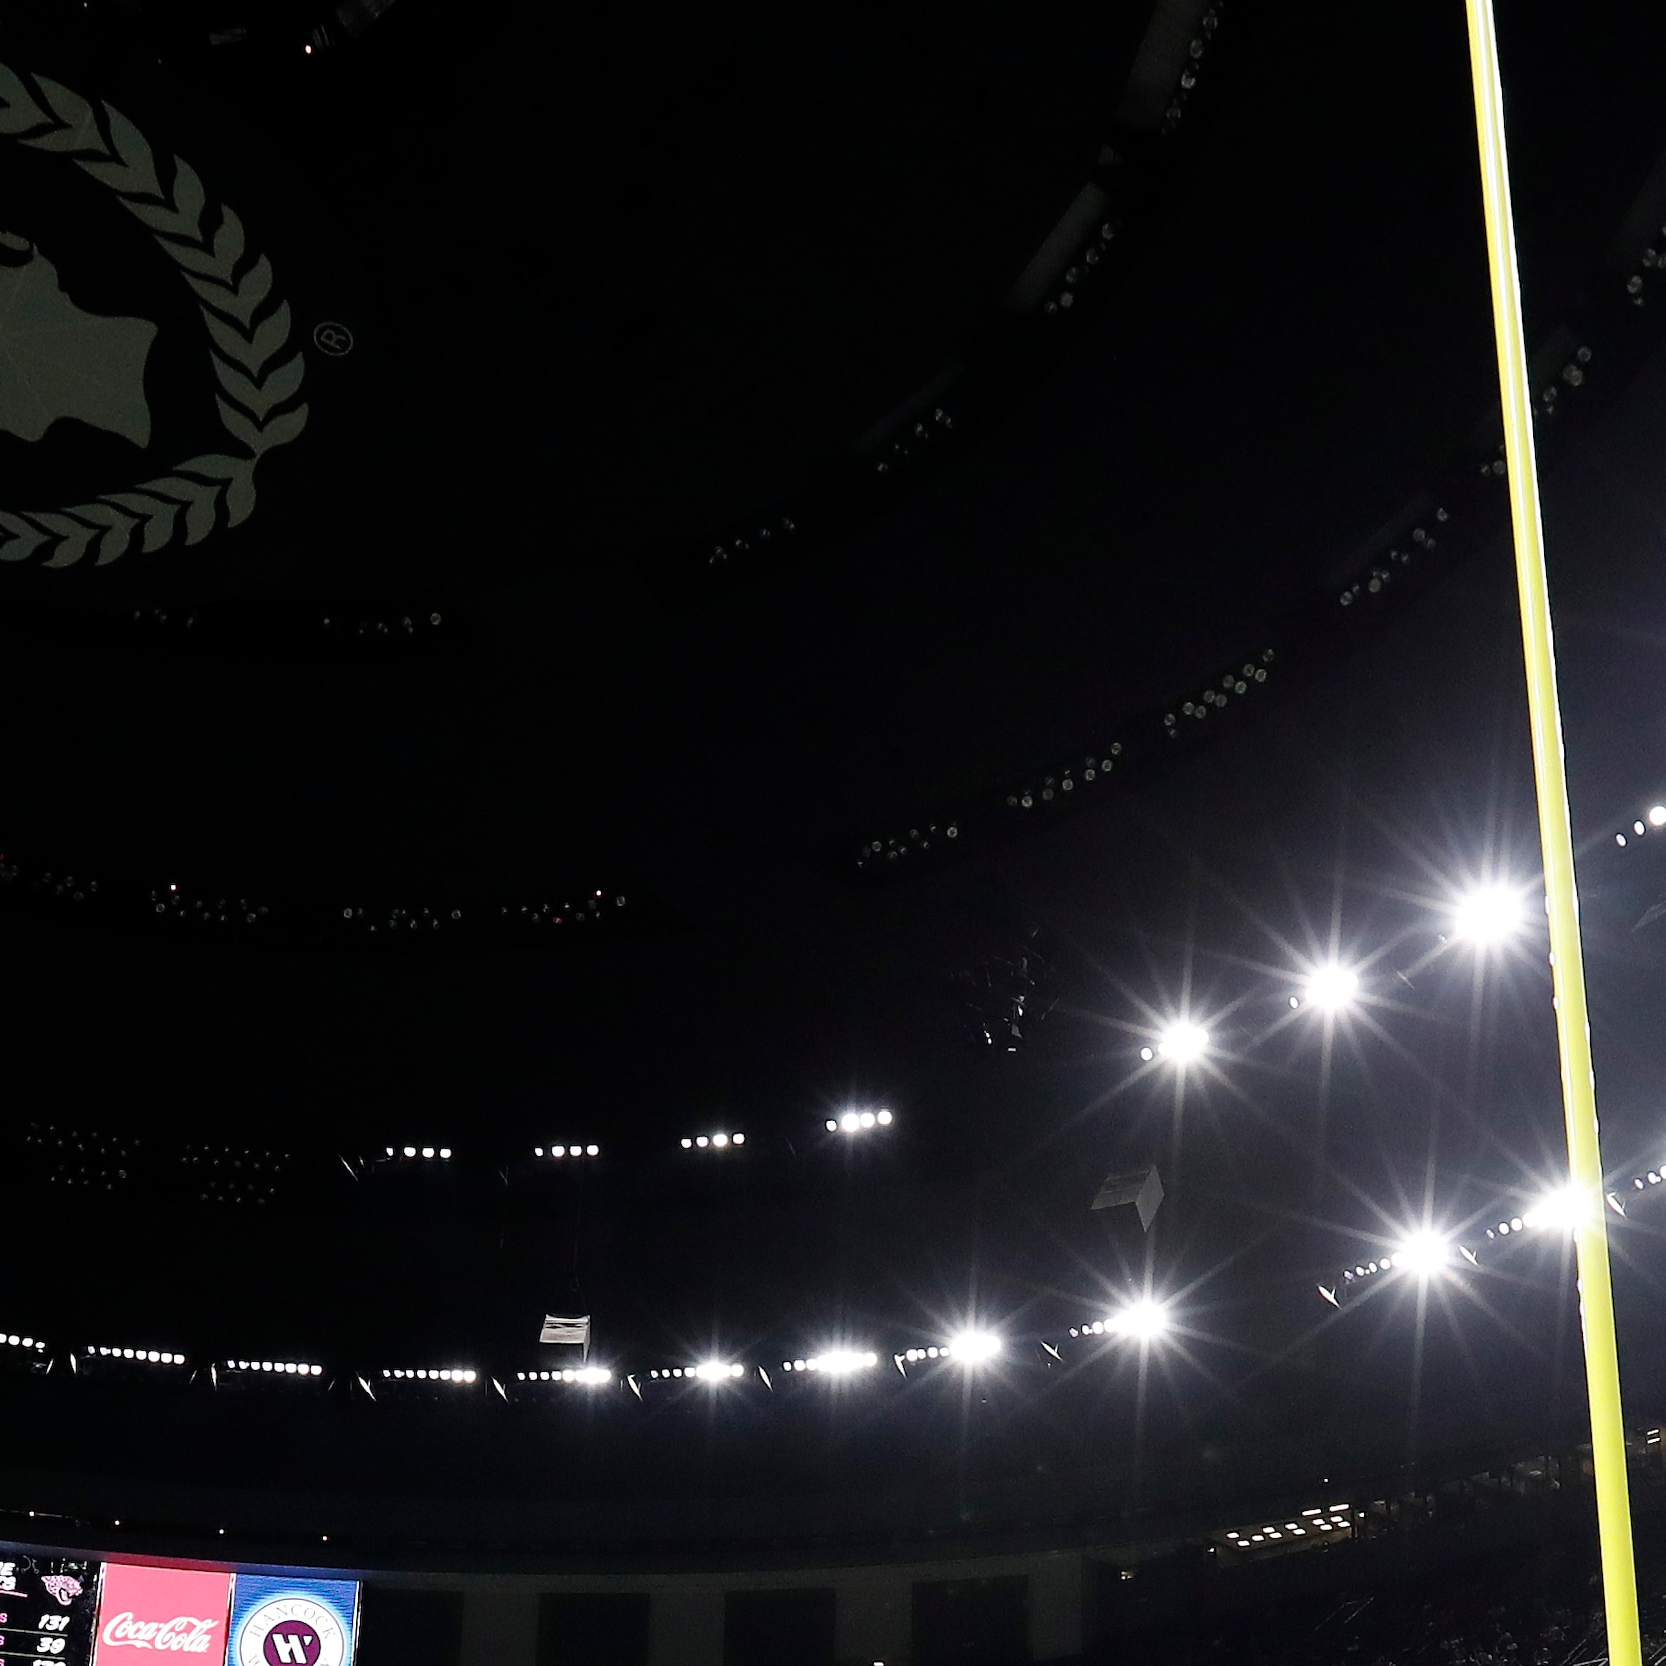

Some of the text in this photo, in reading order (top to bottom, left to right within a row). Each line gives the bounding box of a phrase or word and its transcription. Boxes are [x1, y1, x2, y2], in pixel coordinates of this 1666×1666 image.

[38, 1614, 70, 1632] 131
[249, 1603, 337, 1639] HANCOCK
[36, 1637, 66, 1654] 39
